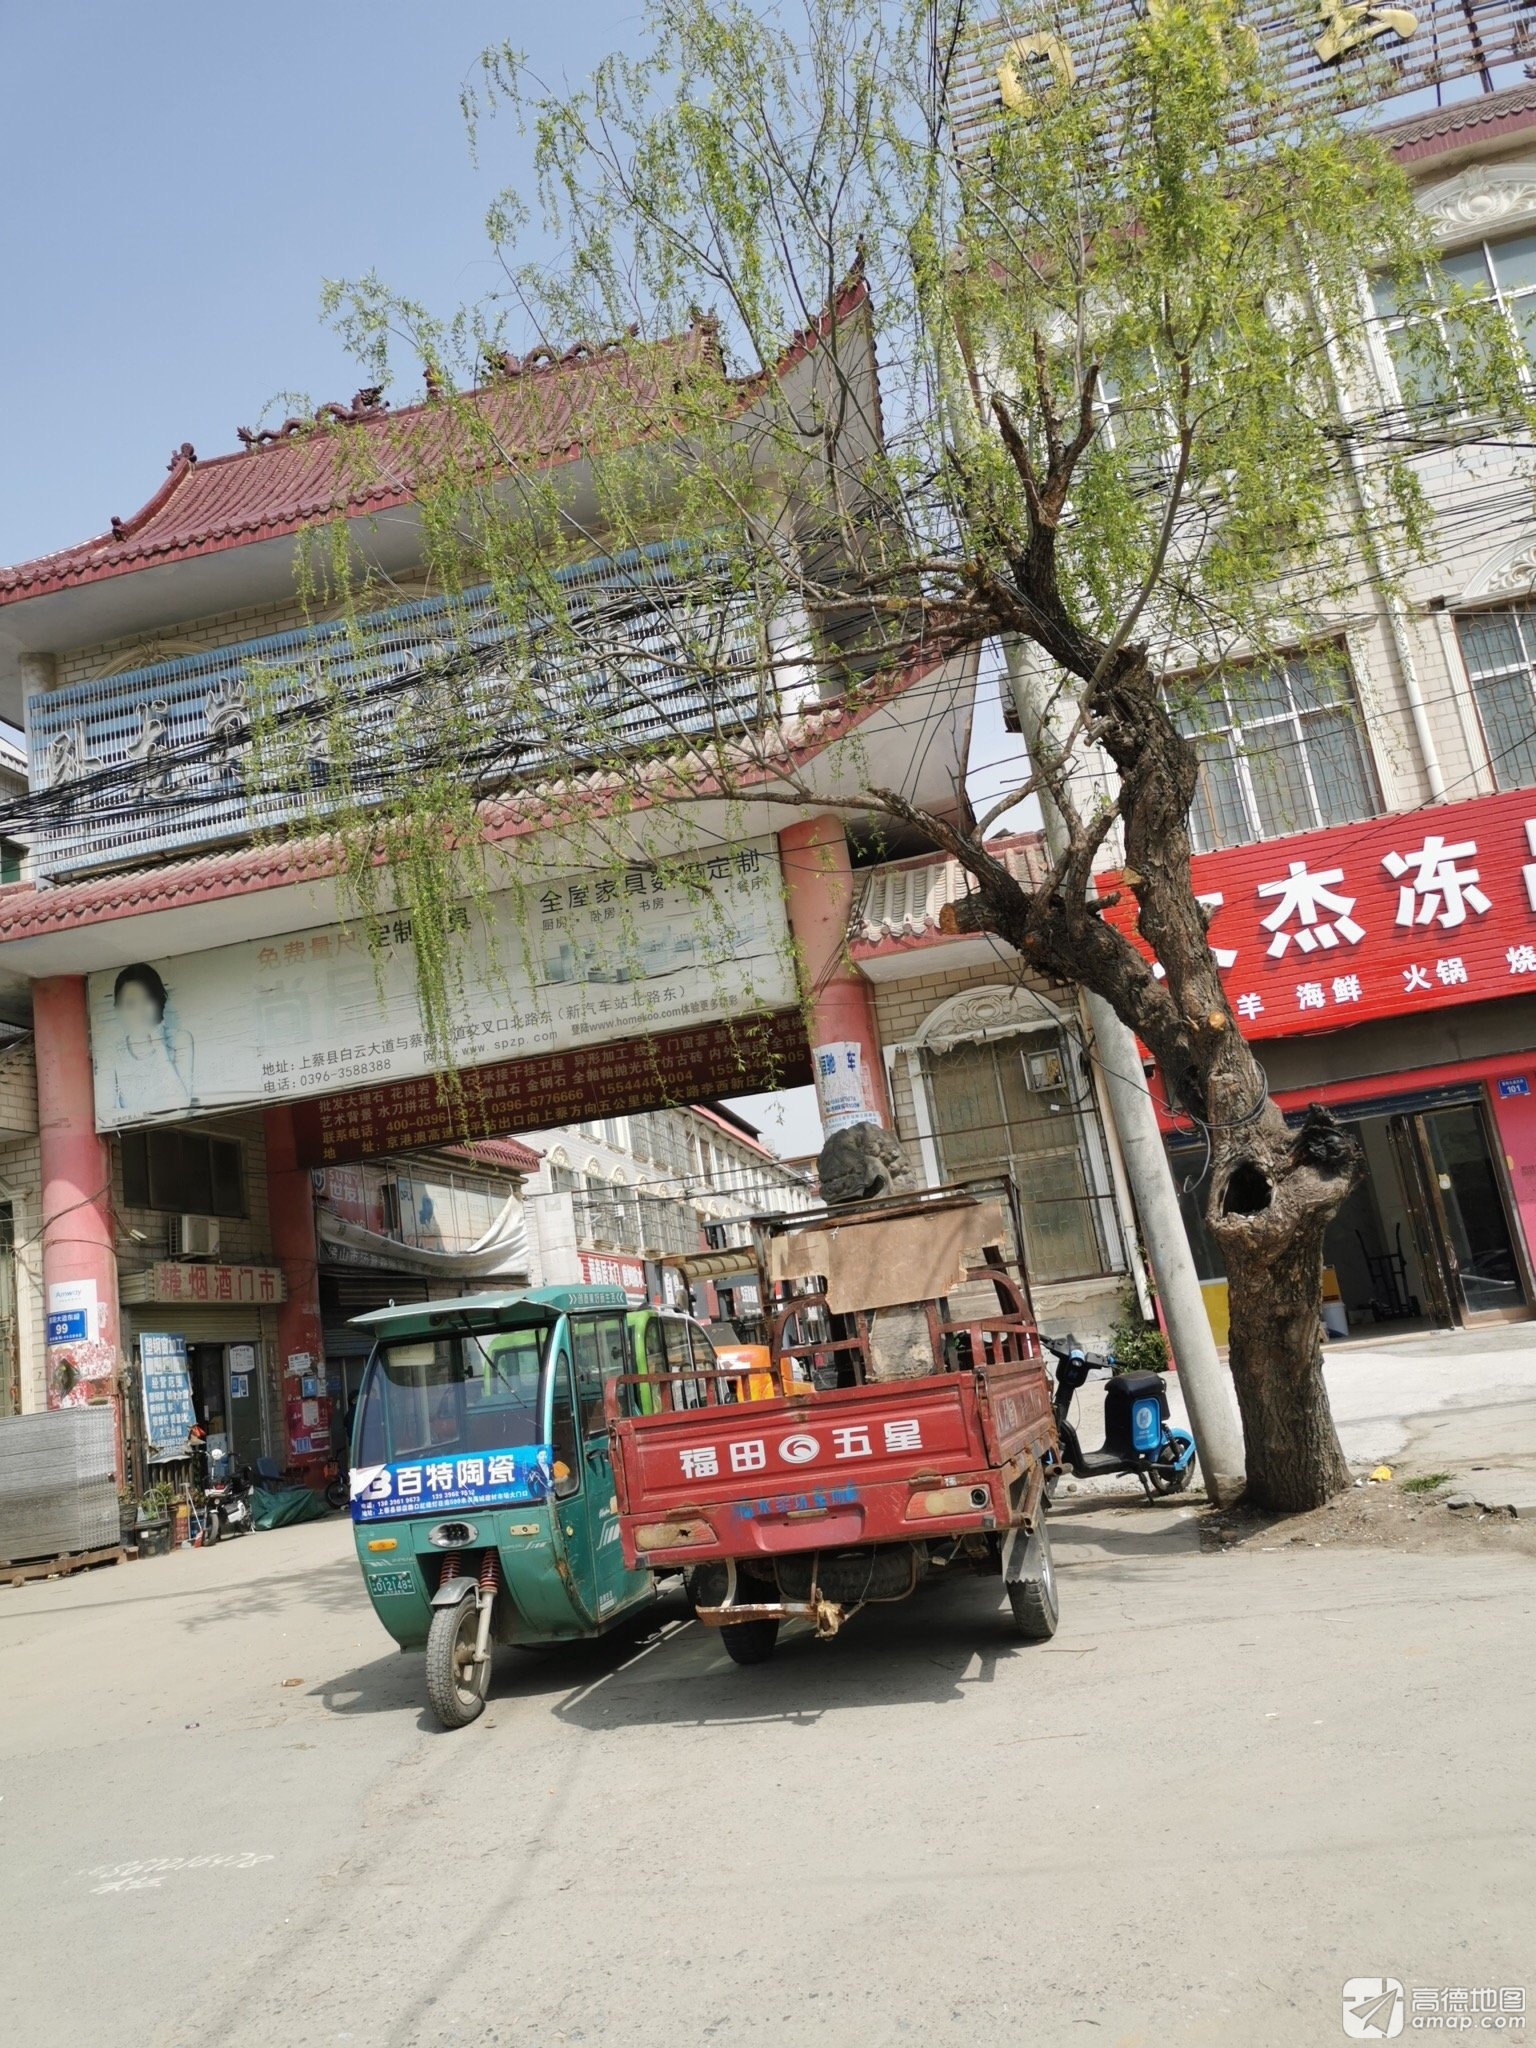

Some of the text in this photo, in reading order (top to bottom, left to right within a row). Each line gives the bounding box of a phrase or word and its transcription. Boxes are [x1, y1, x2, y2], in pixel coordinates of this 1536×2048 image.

[590, 906, 616, 924] 卧房
[639, 897, 665, 914] 书房
[367, 906, 472, 951] 定制具
[1296, 973, 1363, 1012] 海鲜
[1401, 956, 1468, 994] 火锅
[391, 1082, 431, 1101] 花岗岩
[1507, 1084, 1521, 1094] 101
[320, 1108, 373, 1129] 艺术背景
[378, 1096, 432, 1119] 水刀拼花
[160, 1263, 276, 1301] 糖烟酒门市
[55, 1323, 69, 1335] 99
[679, 1419, 923, 1479] 福田 五星
[396, 1454, 516, 1496] 百特陶瓷
